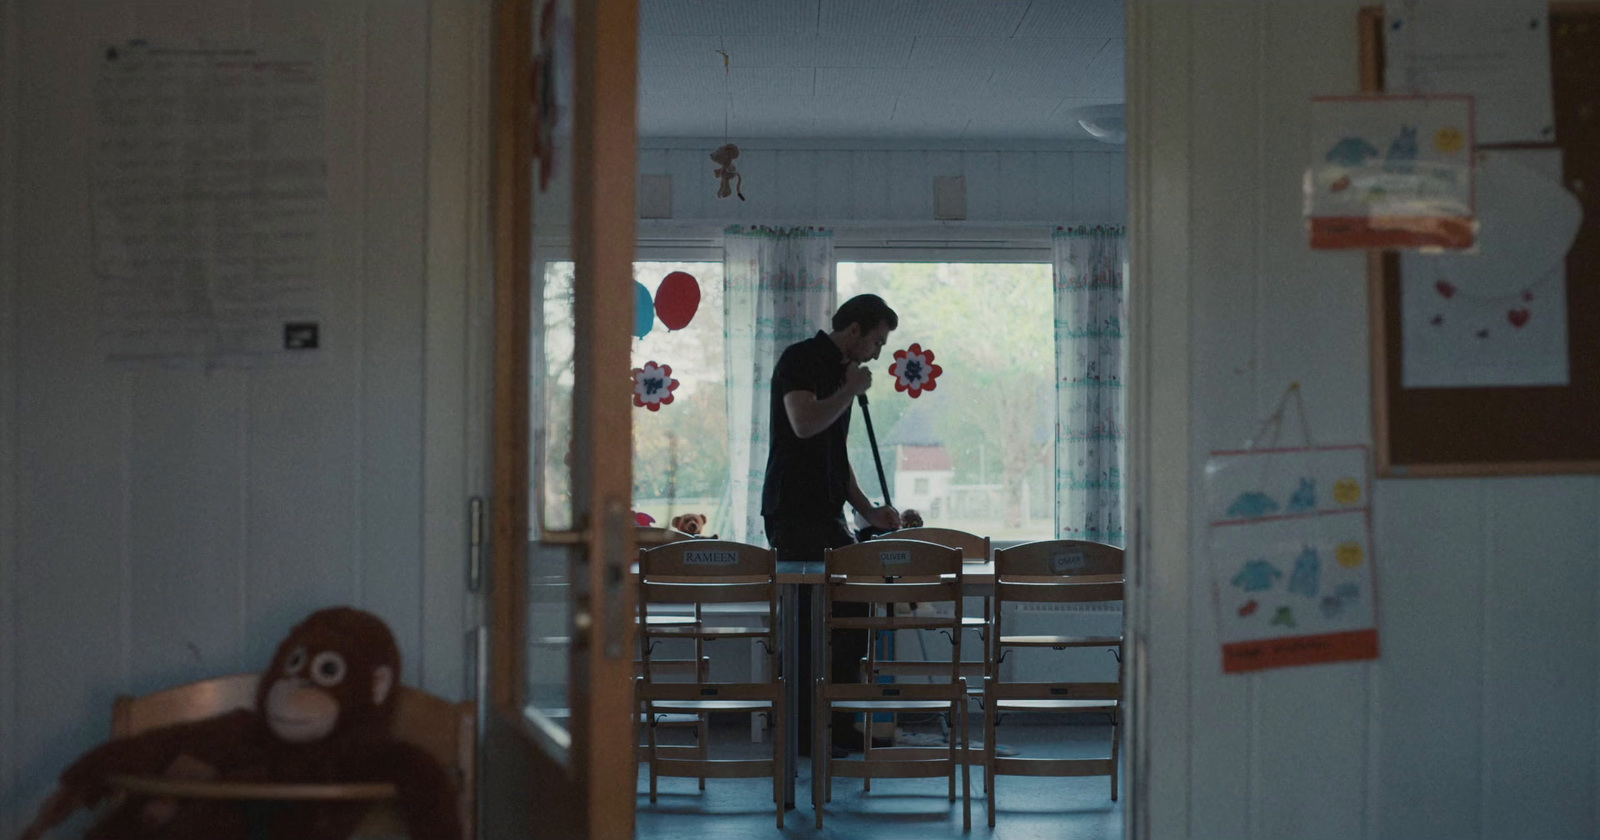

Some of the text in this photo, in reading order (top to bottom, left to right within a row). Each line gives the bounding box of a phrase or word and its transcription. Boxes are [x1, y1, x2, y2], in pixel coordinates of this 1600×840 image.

[686, 552, 736, 562] RAMEEN
[880, 552, 906, 561] OLIVER
[1058, 556, 1081, 566] OMAR
